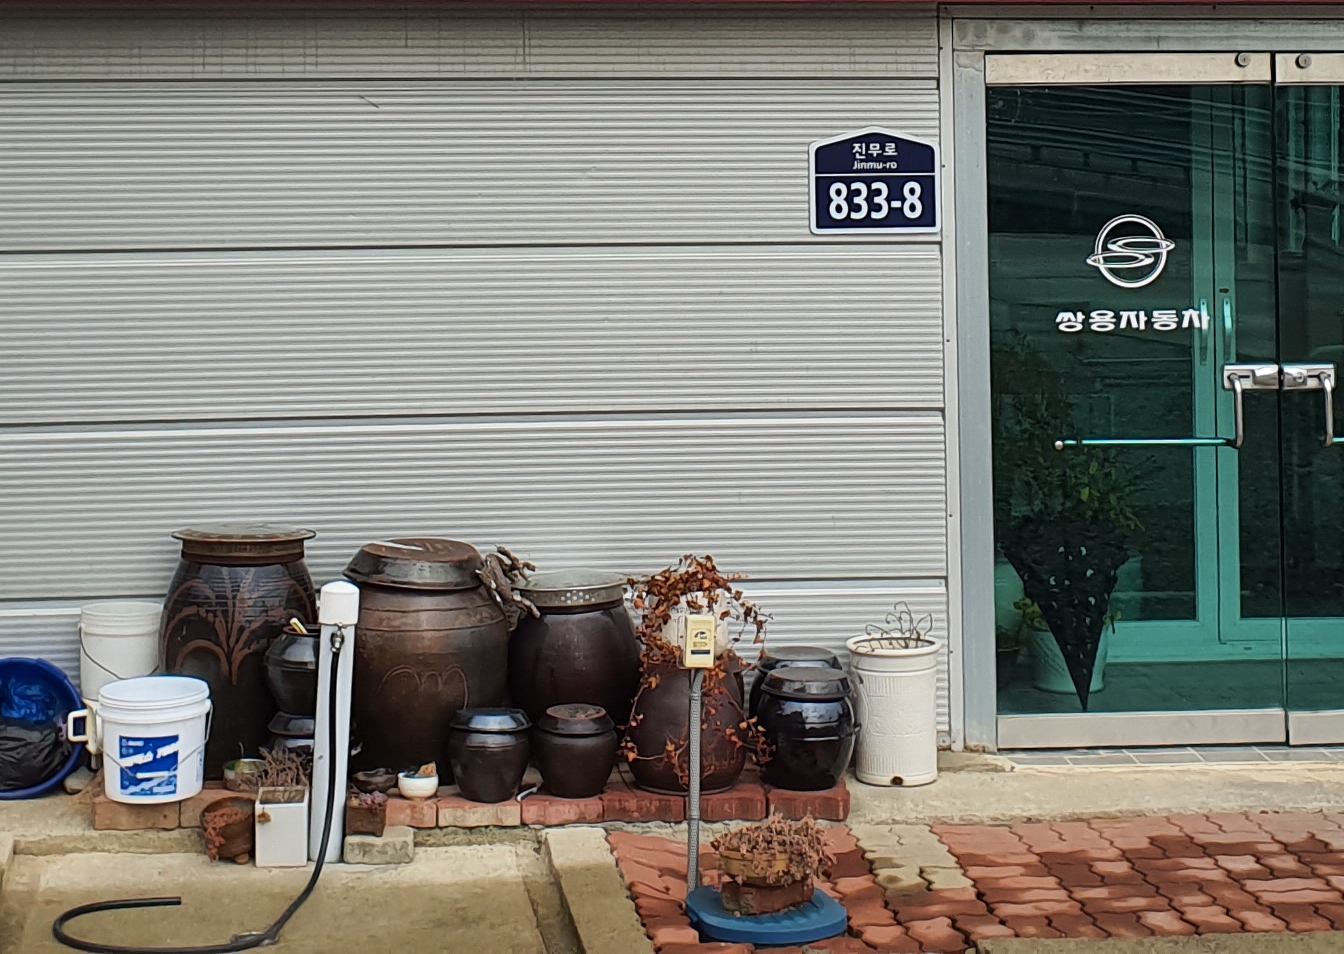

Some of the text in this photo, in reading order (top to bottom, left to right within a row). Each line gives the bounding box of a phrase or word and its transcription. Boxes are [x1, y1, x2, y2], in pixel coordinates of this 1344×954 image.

[852, 142, 898, 159] 진무로
[852, 160, 898, 170] Jinmu-ro
[829, 181, 923, 220] 833-8
[1055, 309, 1210, 332] 쌍용자동차
